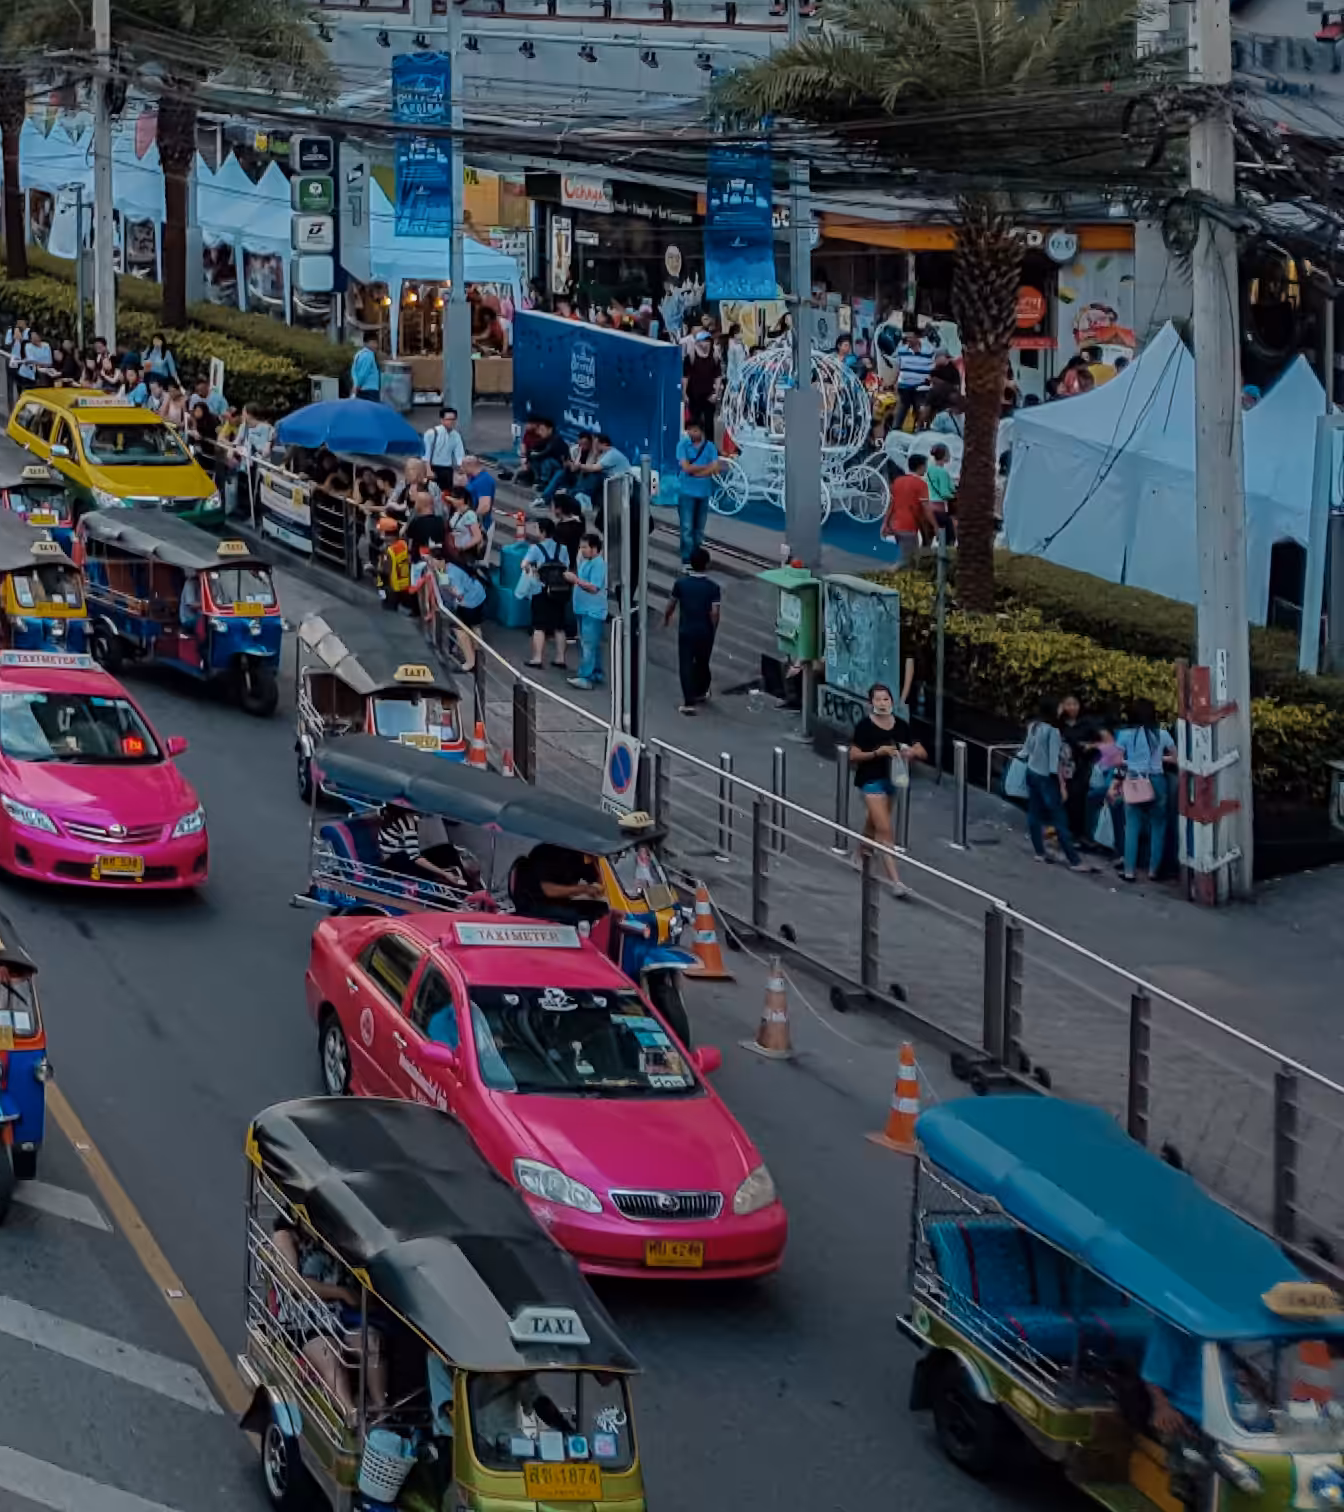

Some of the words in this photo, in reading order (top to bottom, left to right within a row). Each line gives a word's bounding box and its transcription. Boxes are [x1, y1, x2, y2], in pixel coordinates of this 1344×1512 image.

[404, 667, 427, 677] TAXI
[478, 929, 511, 941] TAXI
[511, 930, 560, 942] METER
[532, 1317, 574, 1334] TAXI
